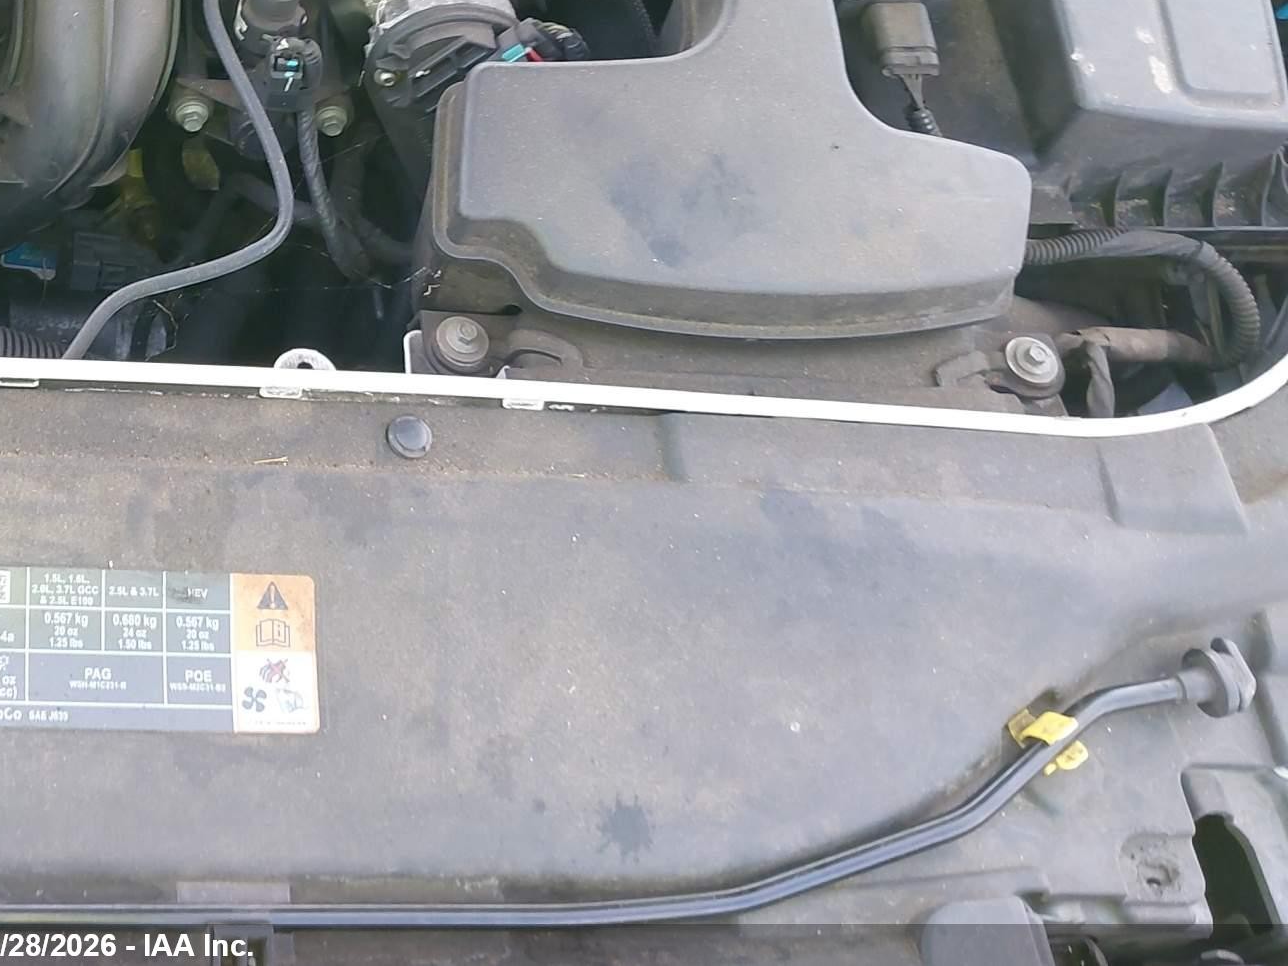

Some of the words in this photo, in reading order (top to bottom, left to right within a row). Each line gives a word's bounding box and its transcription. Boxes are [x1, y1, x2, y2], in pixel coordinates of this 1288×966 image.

[44, 612, 72, 625] 0.567
[74, 612, 89, 628] kg
[112, 614, 141, 627] 0.680
[143, 614, 157, 630] kg
[206, 616, 219, 631] kg
[54, 626, 65, 636] 20
[67, 628, 78, 636] oz
[122, 627, 134, 638] 24
[136, 629, 147, 638] oz
[198, 631, 210, 640] oz
[49, 637, 67, 648] 1.25
[69, 637, 83, 648] lbs
[118, 639, 136, 650] 1.50
[138, 639, 152, 650] lbs
[181, 640, 199, 651] 1.25
[201, 640, 215, 651] lbs
[84, 667, 112, 680] PAG
[185, 670, 212, 682] POE
[2, 675, 16, 686] oz
[0, 686, 17, 699] cc)
